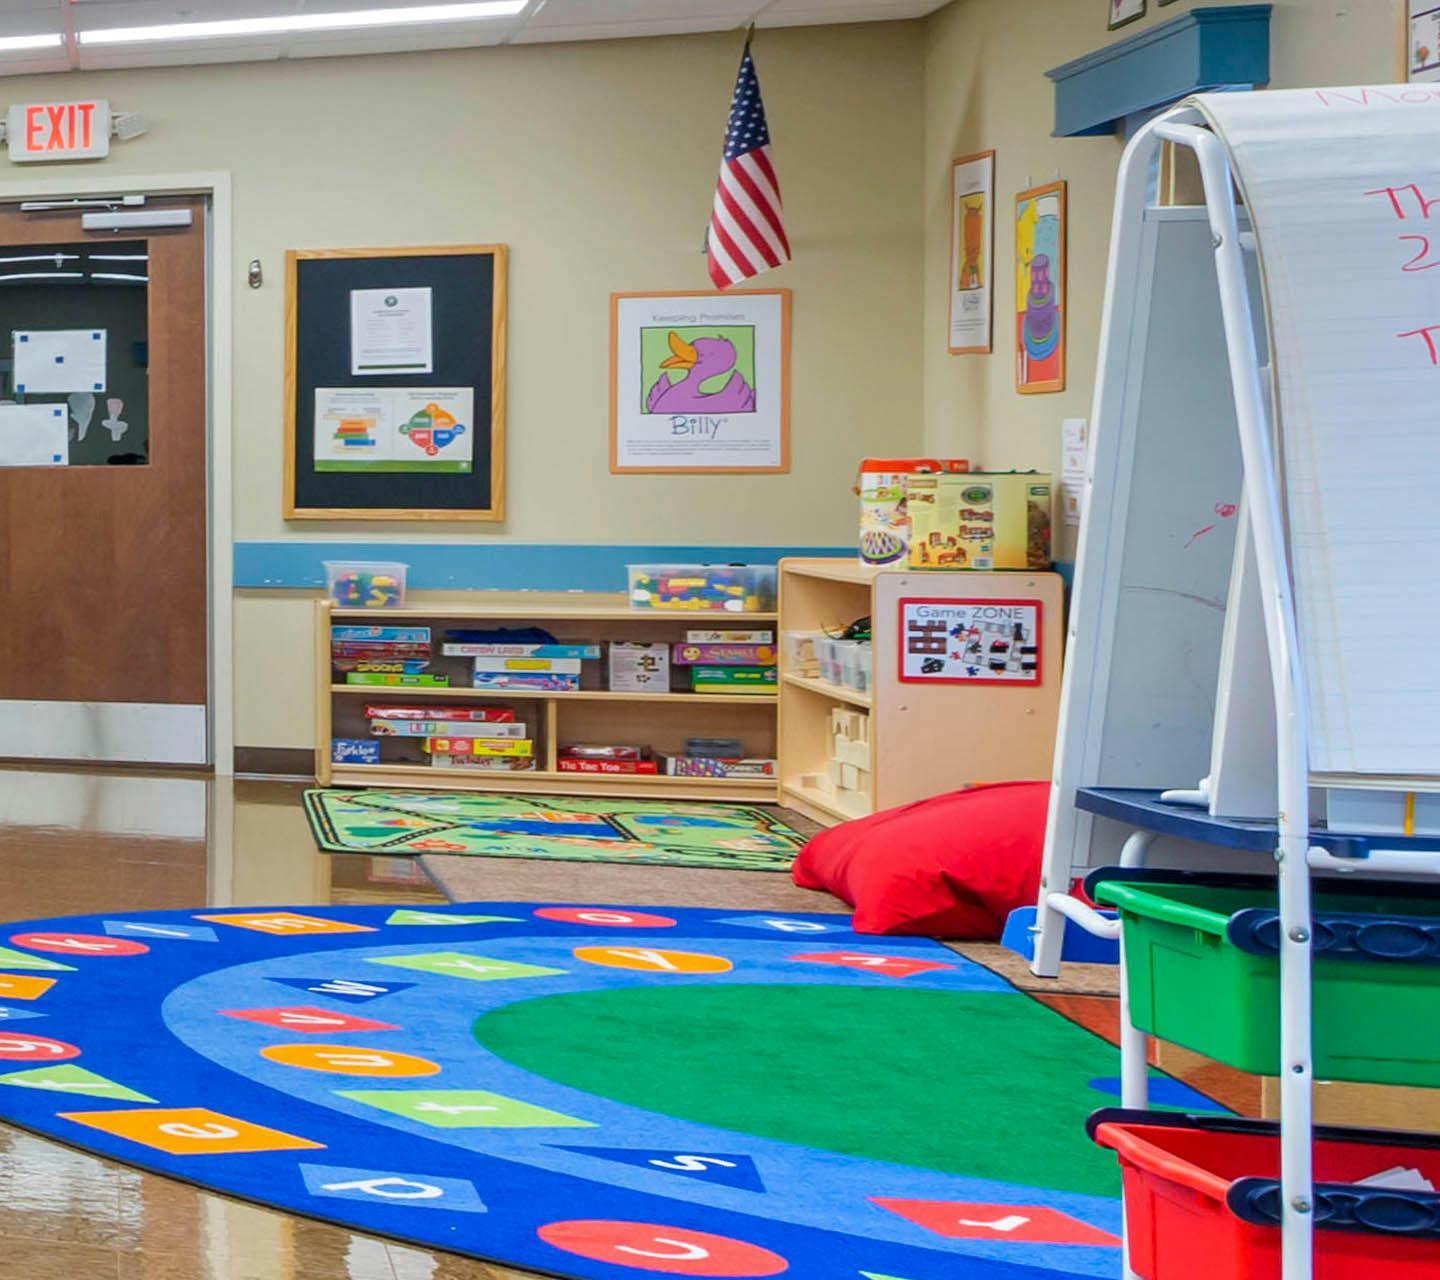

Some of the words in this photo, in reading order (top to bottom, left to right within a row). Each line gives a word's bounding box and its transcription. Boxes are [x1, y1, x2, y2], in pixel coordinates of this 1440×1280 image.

[25, 103, 95, 152] EXIT
[669, 415, 721, 439] Billy
[916, 606, 967, 619] Game
[972, 607, 1025, 619] ZONE
[460, 645, 495, 655] CANDY
[497, 646, 526, 655] LAND
[561, 761, 577, 770] Tic
[579, 761, 600, 771] Tac
[29, 938, 118, 951] k
[279, 1011, 346, 1025] v
[412, 1102, 499, 1114] t
[158, 1122, 240, 1140] e
[648, 1154, 737, 1173] s
[614, 1236, 710, 1261] c
